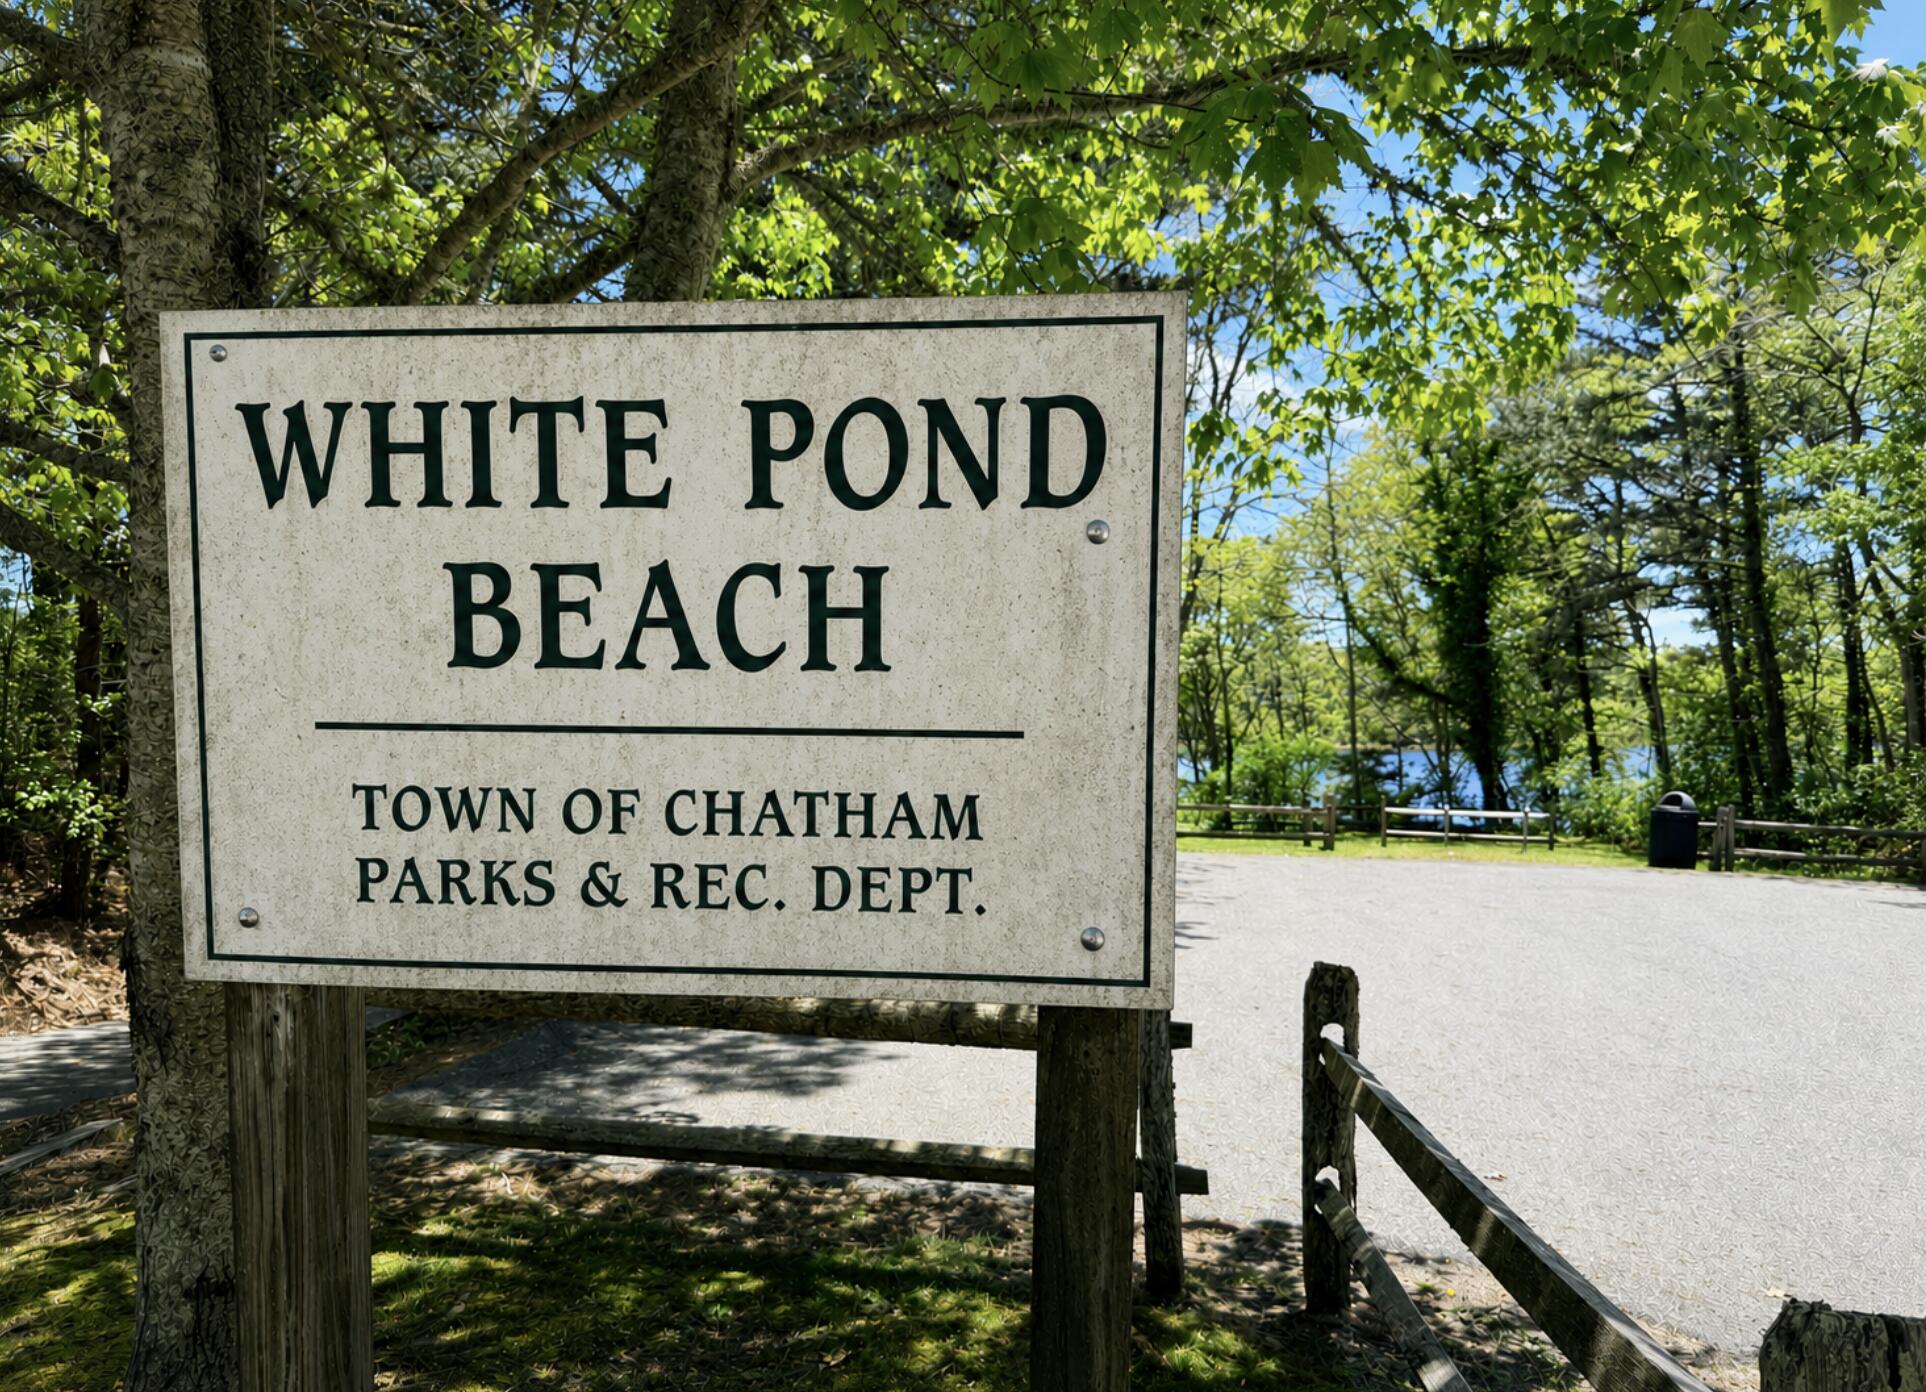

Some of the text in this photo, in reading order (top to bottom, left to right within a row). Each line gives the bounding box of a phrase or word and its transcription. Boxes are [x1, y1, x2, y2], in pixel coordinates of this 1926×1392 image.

[235, 394, 1108, 512] WHITE POND
[442, 558, 892, 673] BEACH
[352, 783, 984, 841] TOWN OF CHATHAM
[355, 857, 987, 916] PARKS & REC. DEPT.
